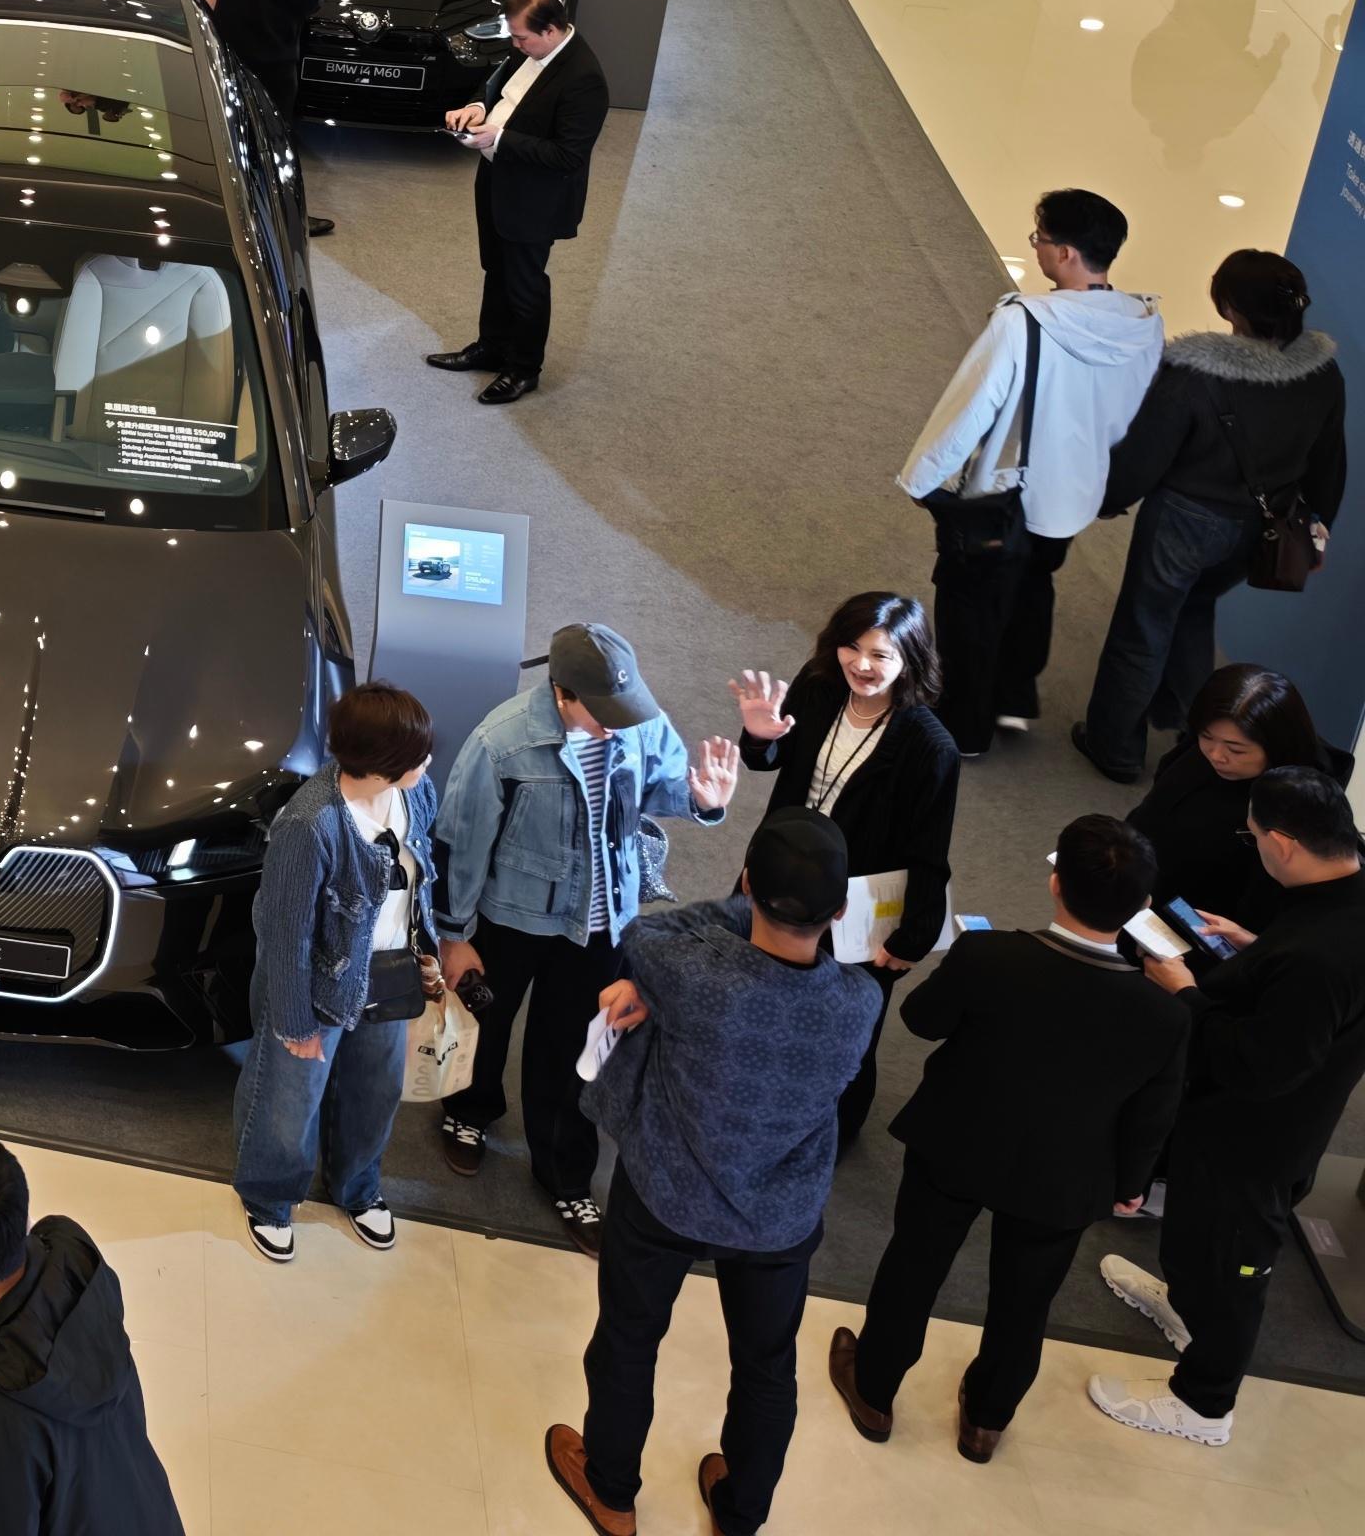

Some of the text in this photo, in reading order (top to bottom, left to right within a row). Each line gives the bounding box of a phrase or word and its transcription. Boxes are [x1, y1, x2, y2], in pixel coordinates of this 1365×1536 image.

[326, 62, 401, 79] BMW i4 M60
